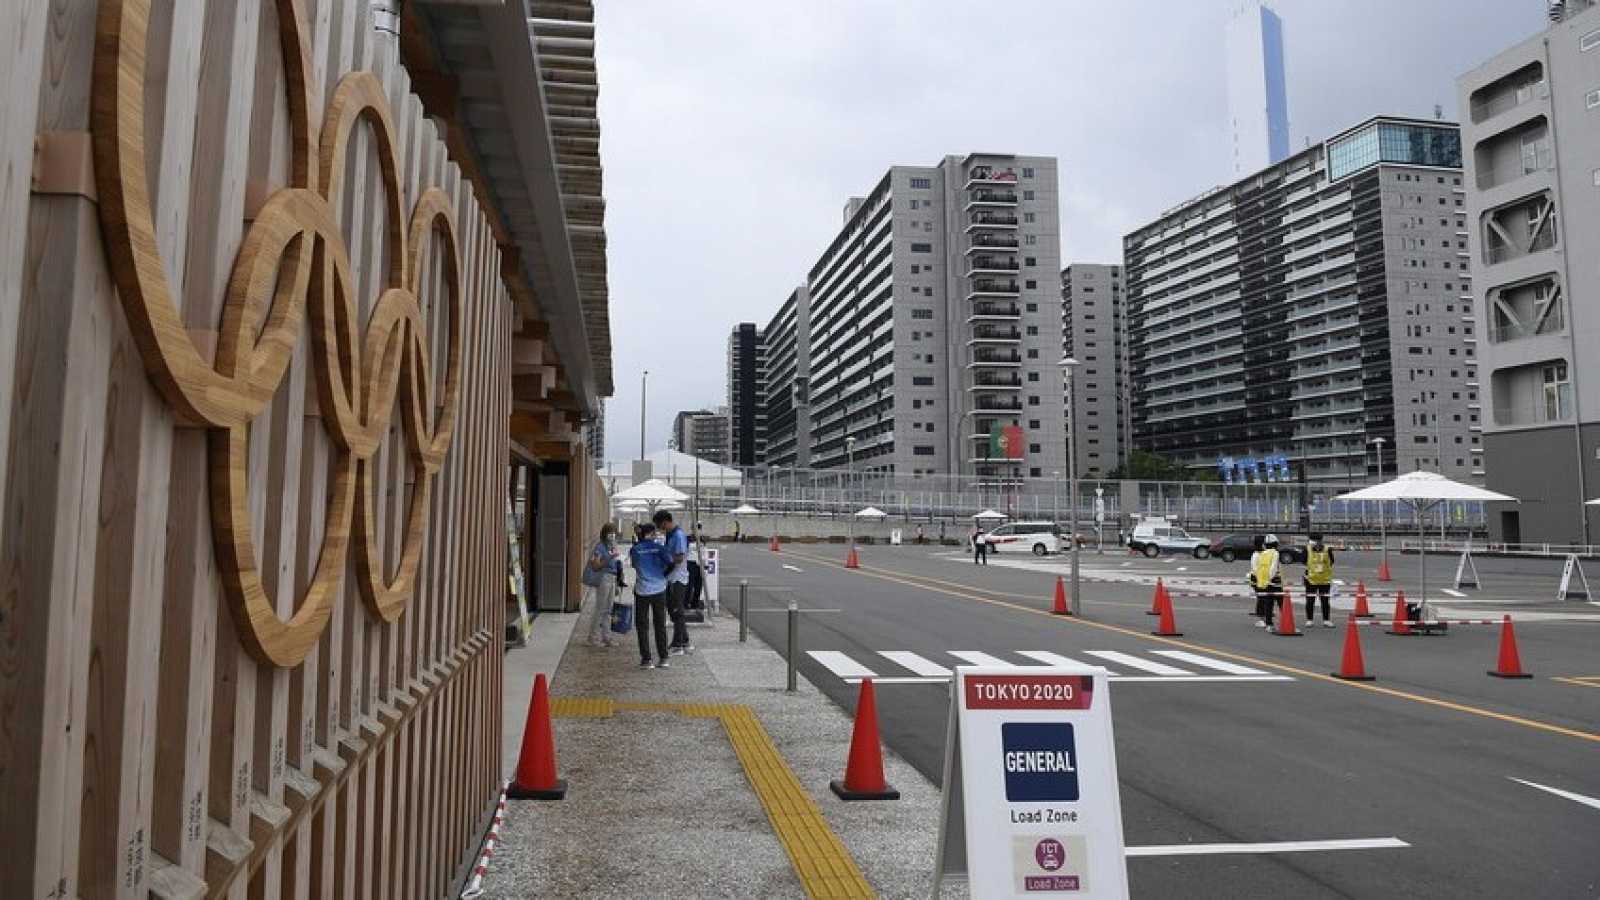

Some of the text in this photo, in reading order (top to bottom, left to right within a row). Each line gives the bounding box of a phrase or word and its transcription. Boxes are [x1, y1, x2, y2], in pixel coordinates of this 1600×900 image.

[975, 684, 1073, 700] TOKYO 2020
[1007, 752, 1075, 772] GENERAL
[1011, 809, 1077, 823] Load Zone
[1041, 843, 1058, 854] TCT
[1028, 878, 1076, 890] Load Zone
